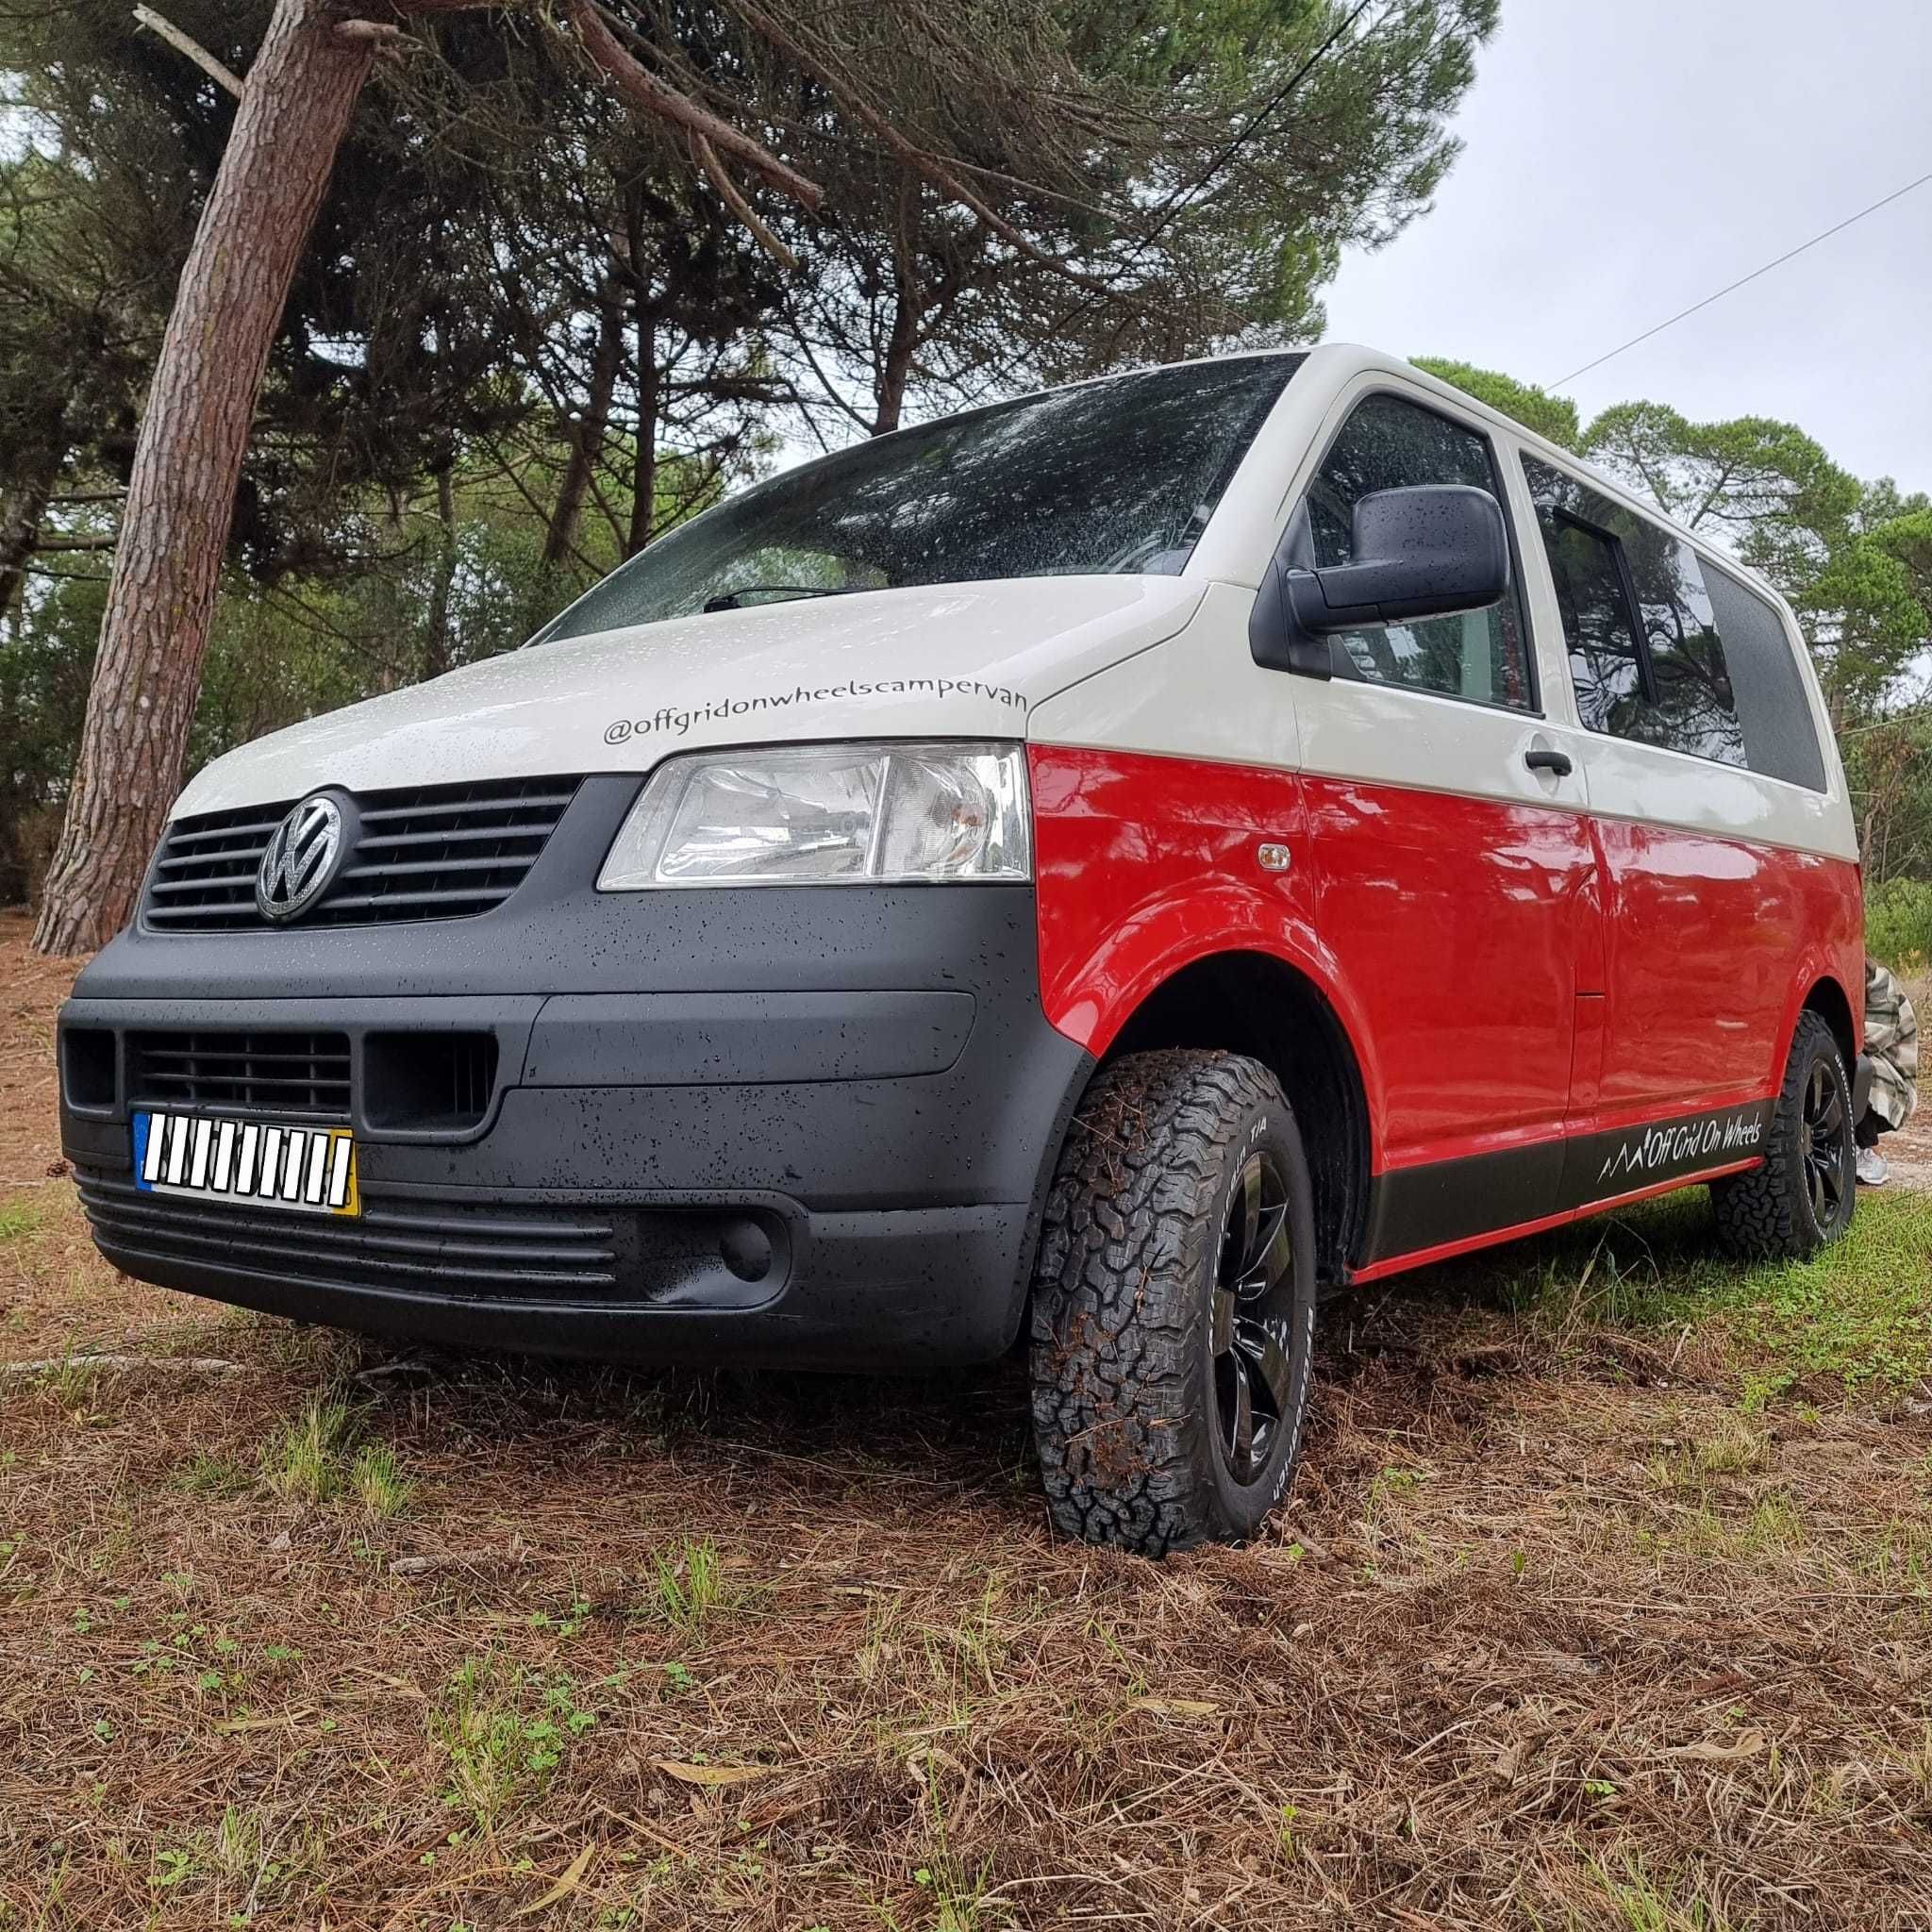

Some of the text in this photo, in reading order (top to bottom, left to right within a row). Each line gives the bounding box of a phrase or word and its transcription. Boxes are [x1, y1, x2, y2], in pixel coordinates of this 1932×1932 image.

[604, 678, 1027, 745] @offgridonwheelscampervan
[1647, 1111, 1762, 1169] Off Grid On Wheels
